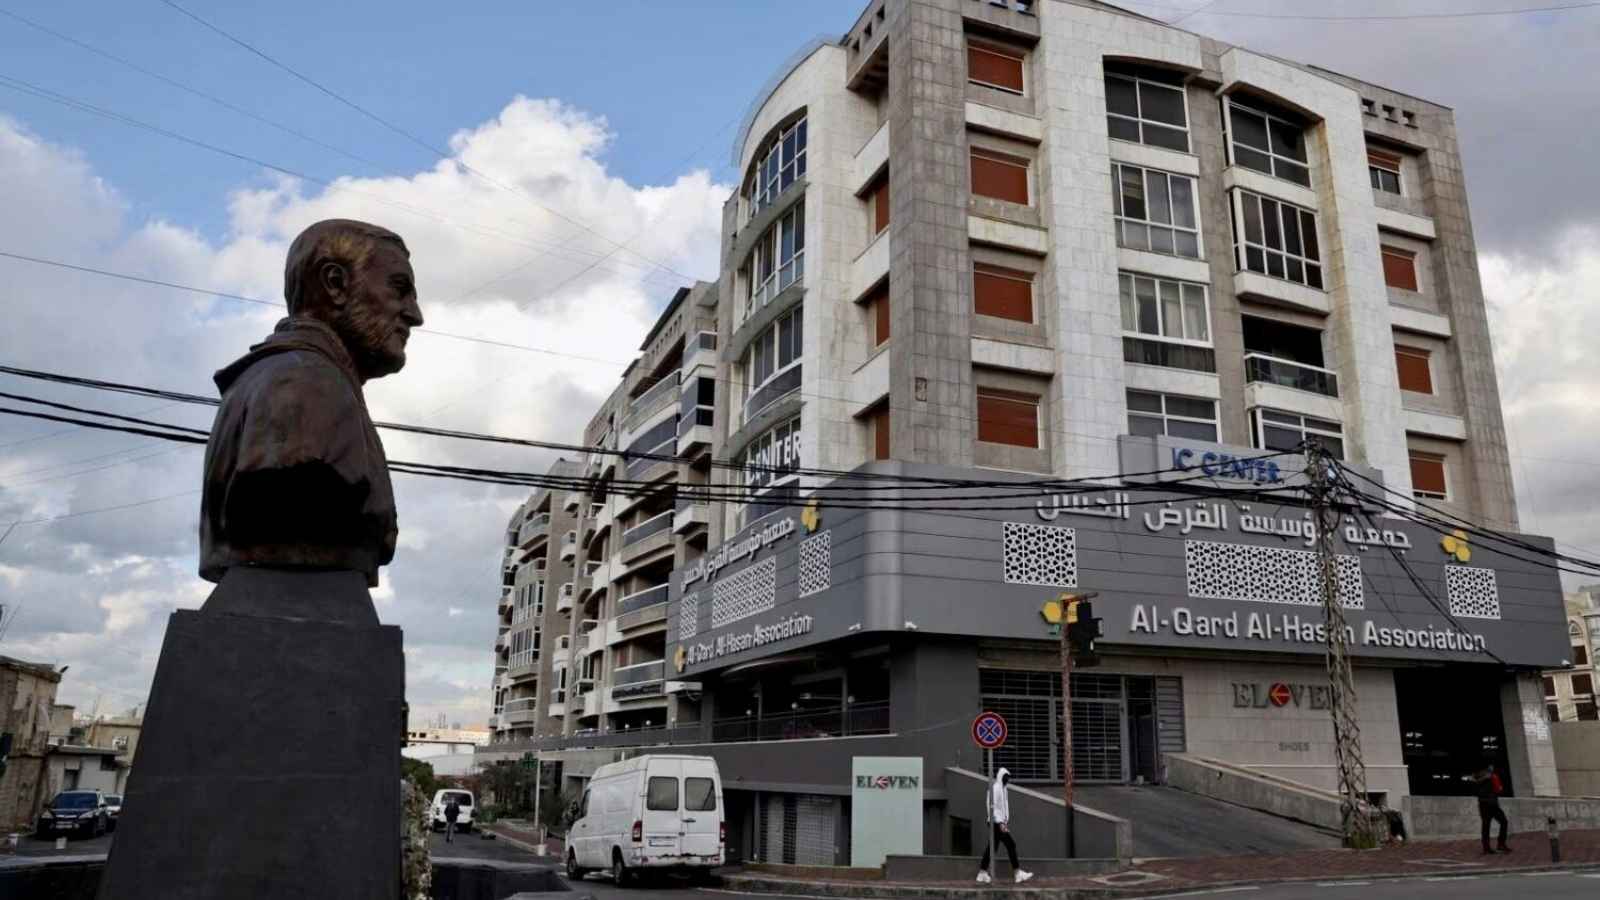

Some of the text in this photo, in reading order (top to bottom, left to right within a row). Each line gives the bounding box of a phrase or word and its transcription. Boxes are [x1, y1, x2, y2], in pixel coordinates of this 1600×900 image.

[1171, 448, 1280, 483] IC CENTER
[1035, 489, 1412, 554] جمعية ؤسسة القرض الحسن
[753, 611, 813, 648] Association
[1130, 604, 1486, 651] Al-Qard Al-Hasn Association
